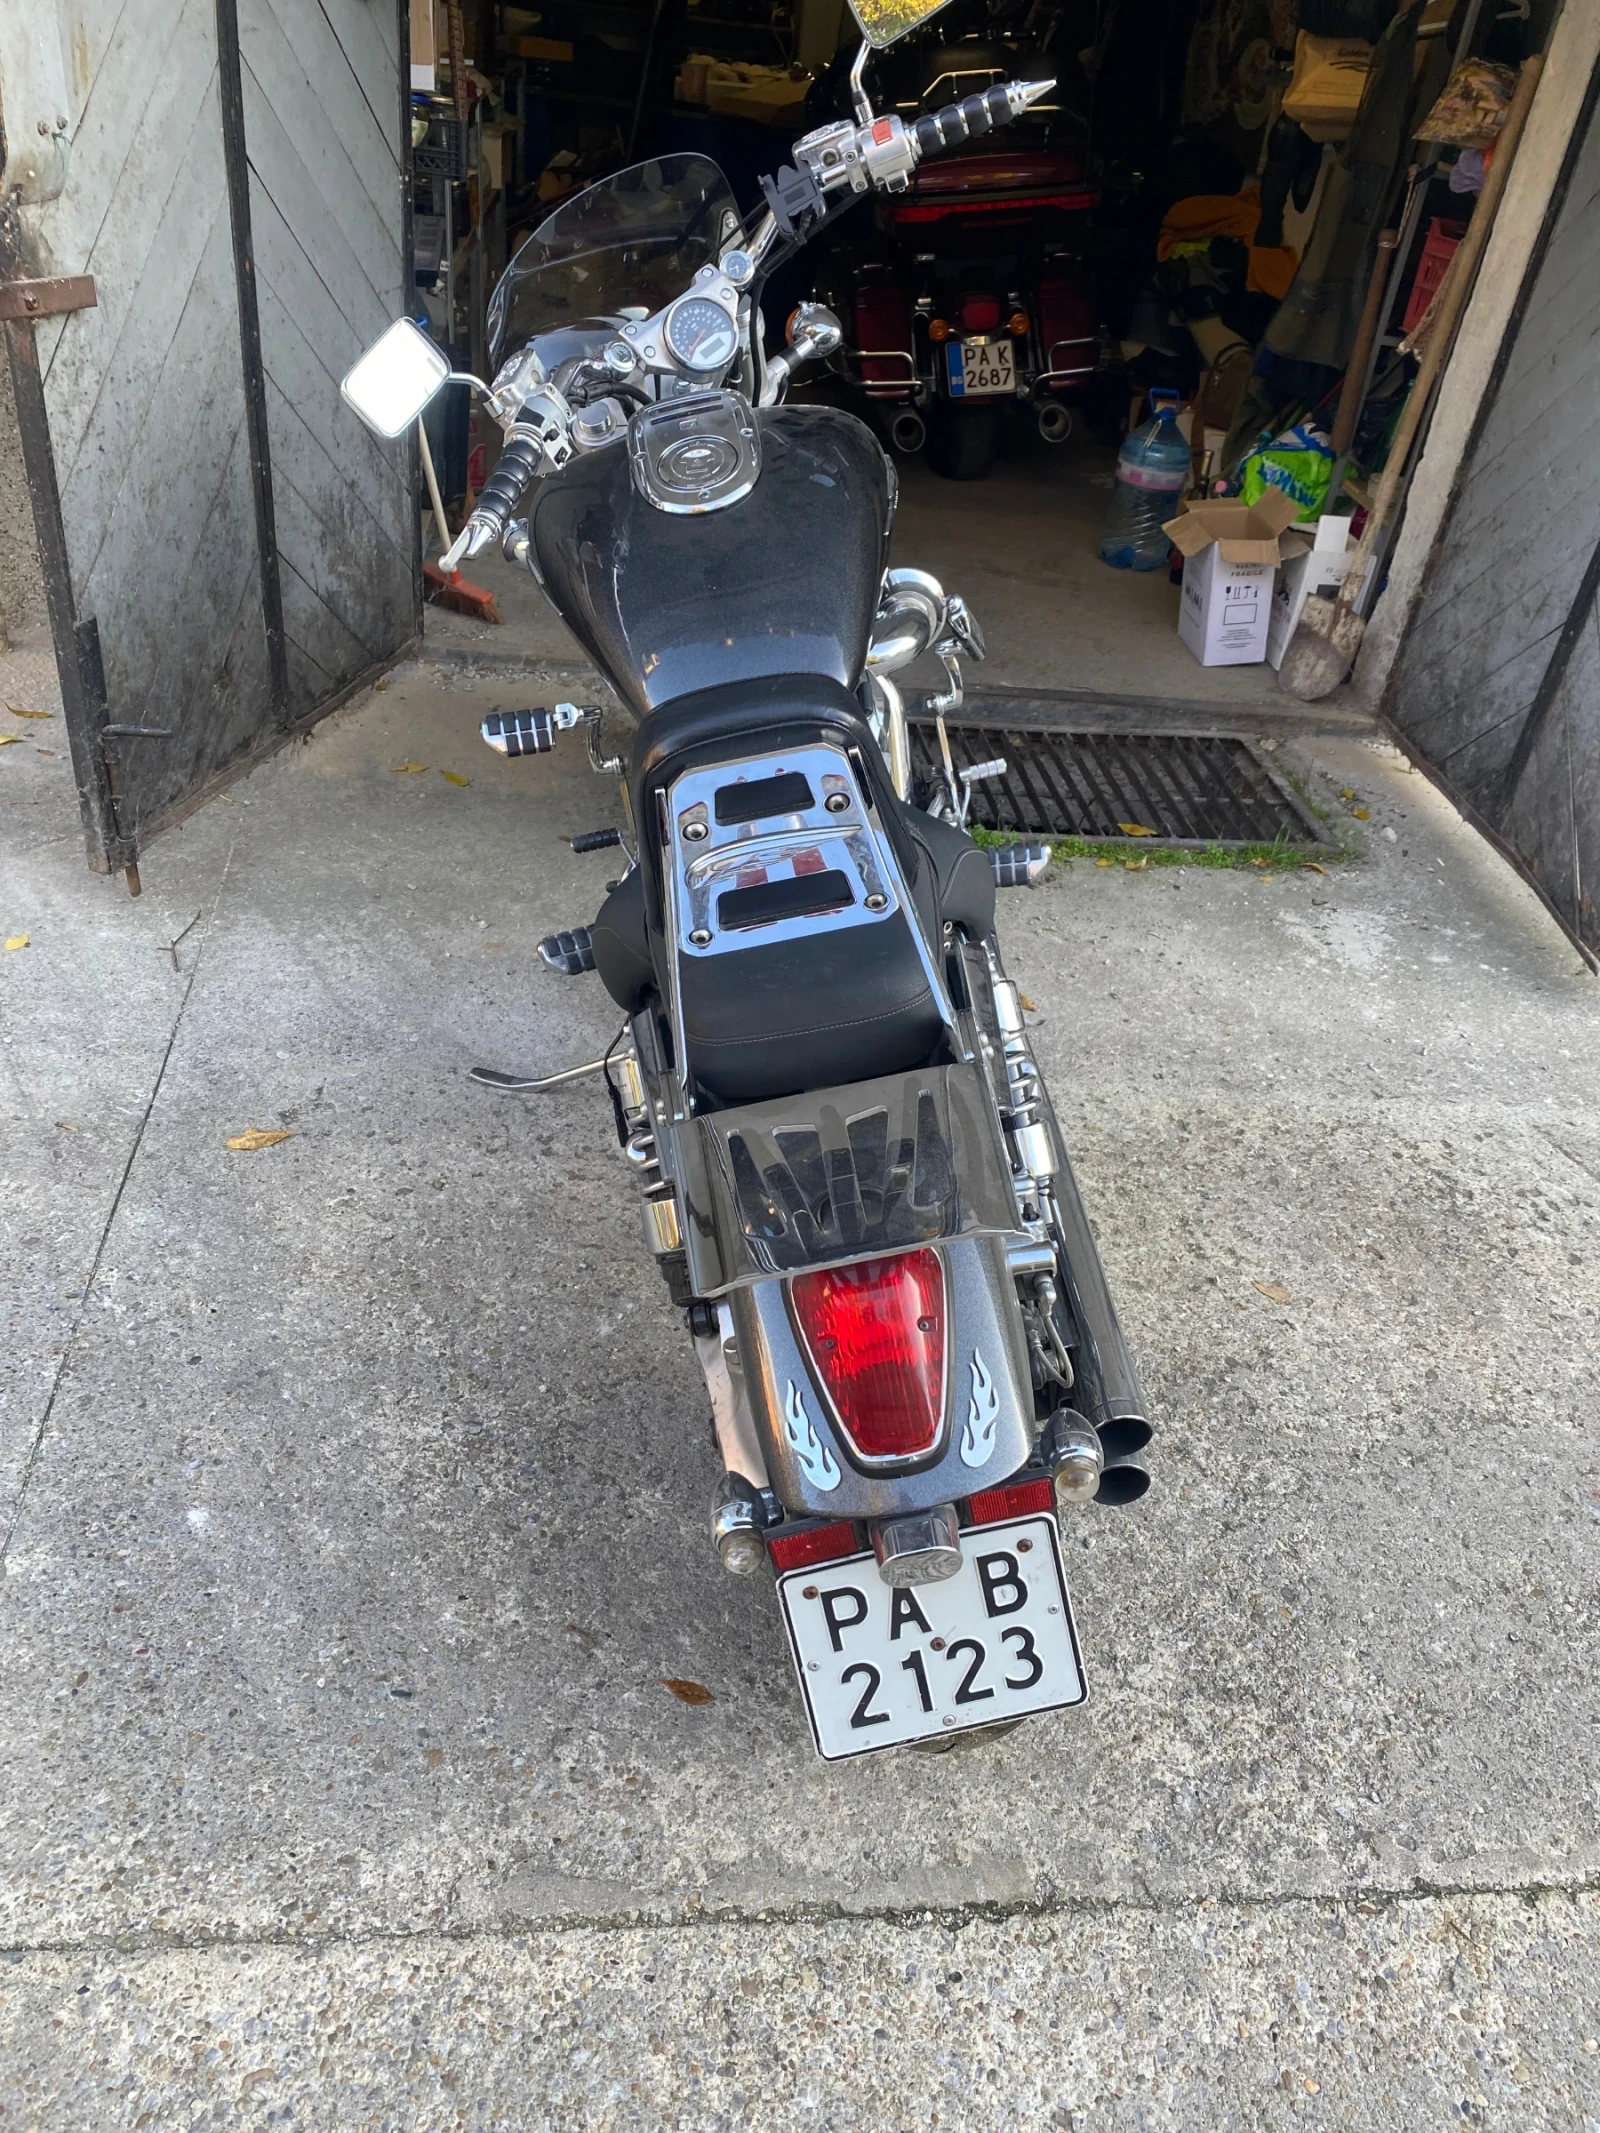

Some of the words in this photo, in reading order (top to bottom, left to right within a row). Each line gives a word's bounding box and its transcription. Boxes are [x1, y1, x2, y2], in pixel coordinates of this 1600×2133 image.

[964, 347, 990, 366] PA
[997, 345, 1010, 365] K
[951, 375, 963, 386] BG
[965, 367, 1012, 388] 2687
[1231, 569, 1264, 578] FRAGILE
[820, 1586, 932, 1653] PA
[975, 1550, 1029, 1619] B
[840, 1625, 1045, 1730] 2123
